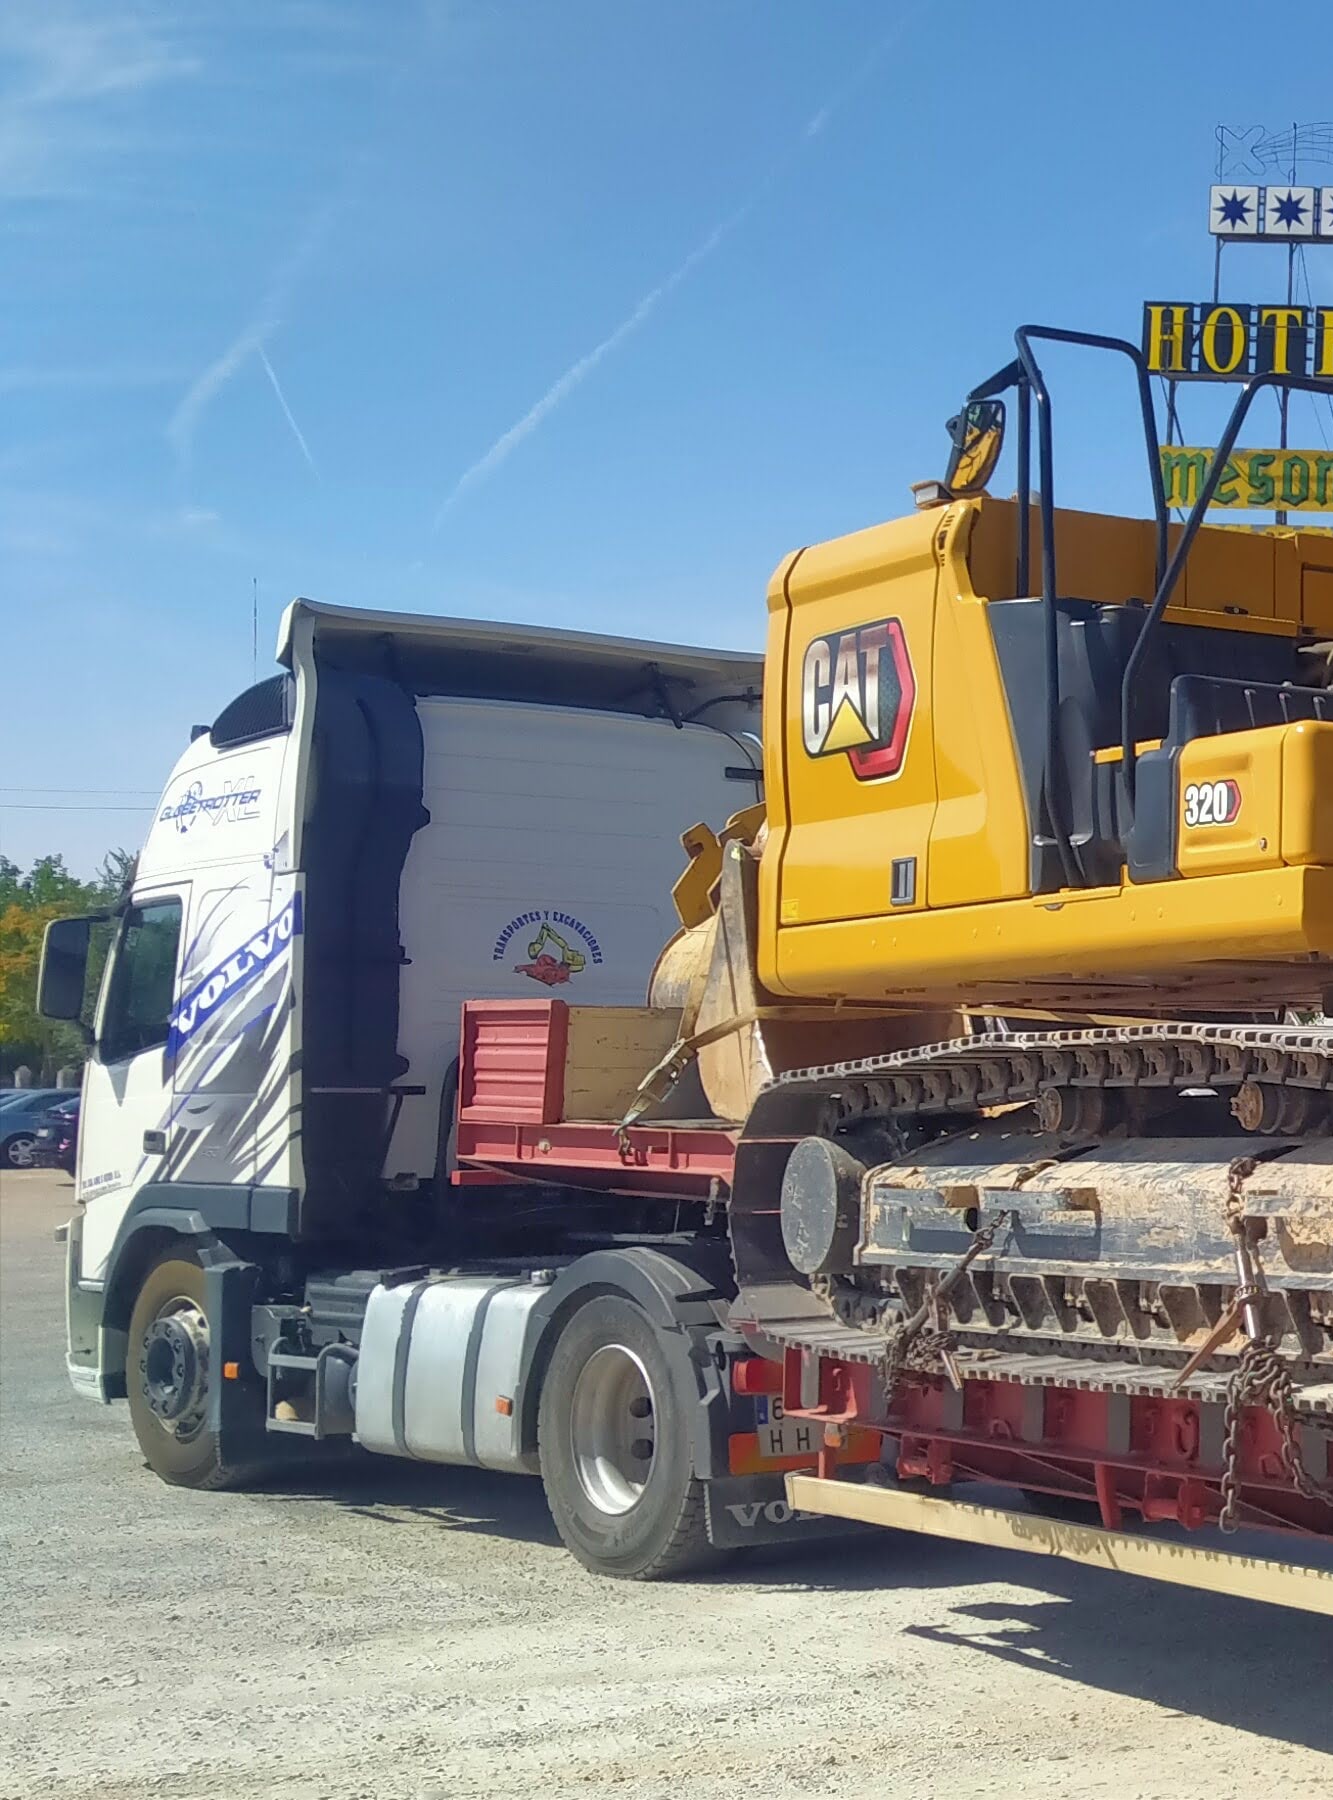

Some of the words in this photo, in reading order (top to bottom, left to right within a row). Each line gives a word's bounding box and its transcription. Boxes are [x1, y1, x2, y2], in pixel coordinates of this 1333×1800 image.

[803, 622, 890, 755] CAT
[159, 788, 262, 823] GLOBETROTTER
[1185, 782, 1228, 825] 320
[493, 910, 541, 961] TRANSPORTES
[543, 910, 550, 921] Y
[552, 911, 603, 965] EXCAVACIONES
[170, 907, 294, 1034] VOLVO
